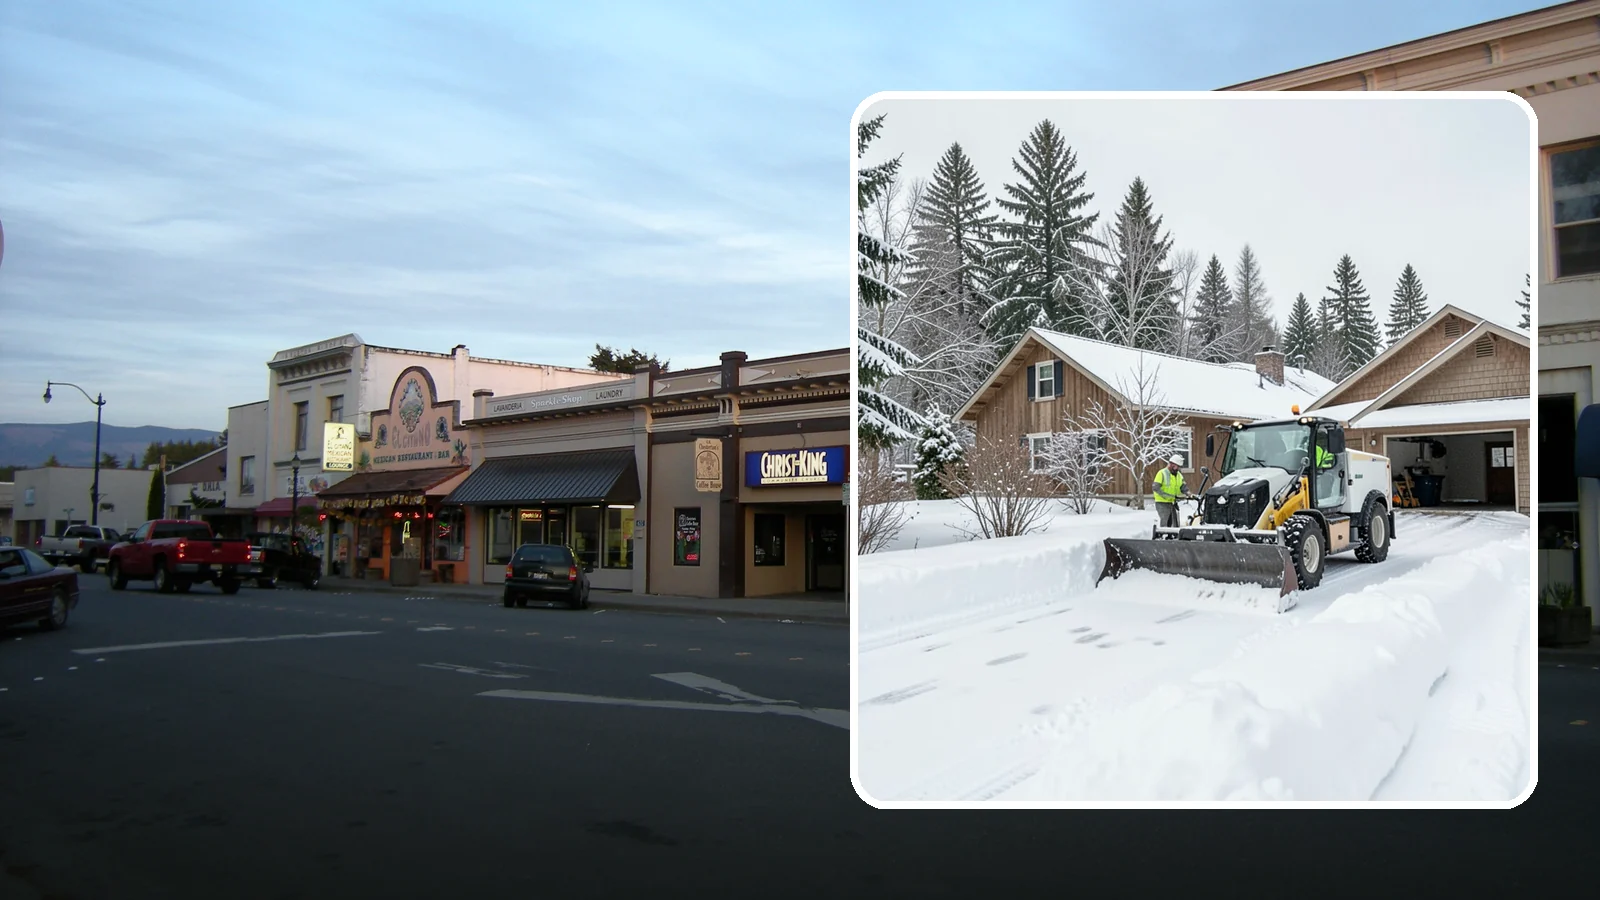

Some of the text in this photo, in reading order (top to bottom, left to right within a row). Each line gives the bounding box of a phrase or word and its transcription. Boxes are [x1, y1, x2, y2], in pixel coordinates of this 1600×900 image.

[531, 394, 582, 408] Sparkle Shop
[596, 389, 623, 400] LAUNDRY
[494, 402, 522, 412] LAVANDERIA
[374, 450, 450, 464] MEXICAN RESTAURANT BAR
[761, 450, 827, 478] CHRIST KING
